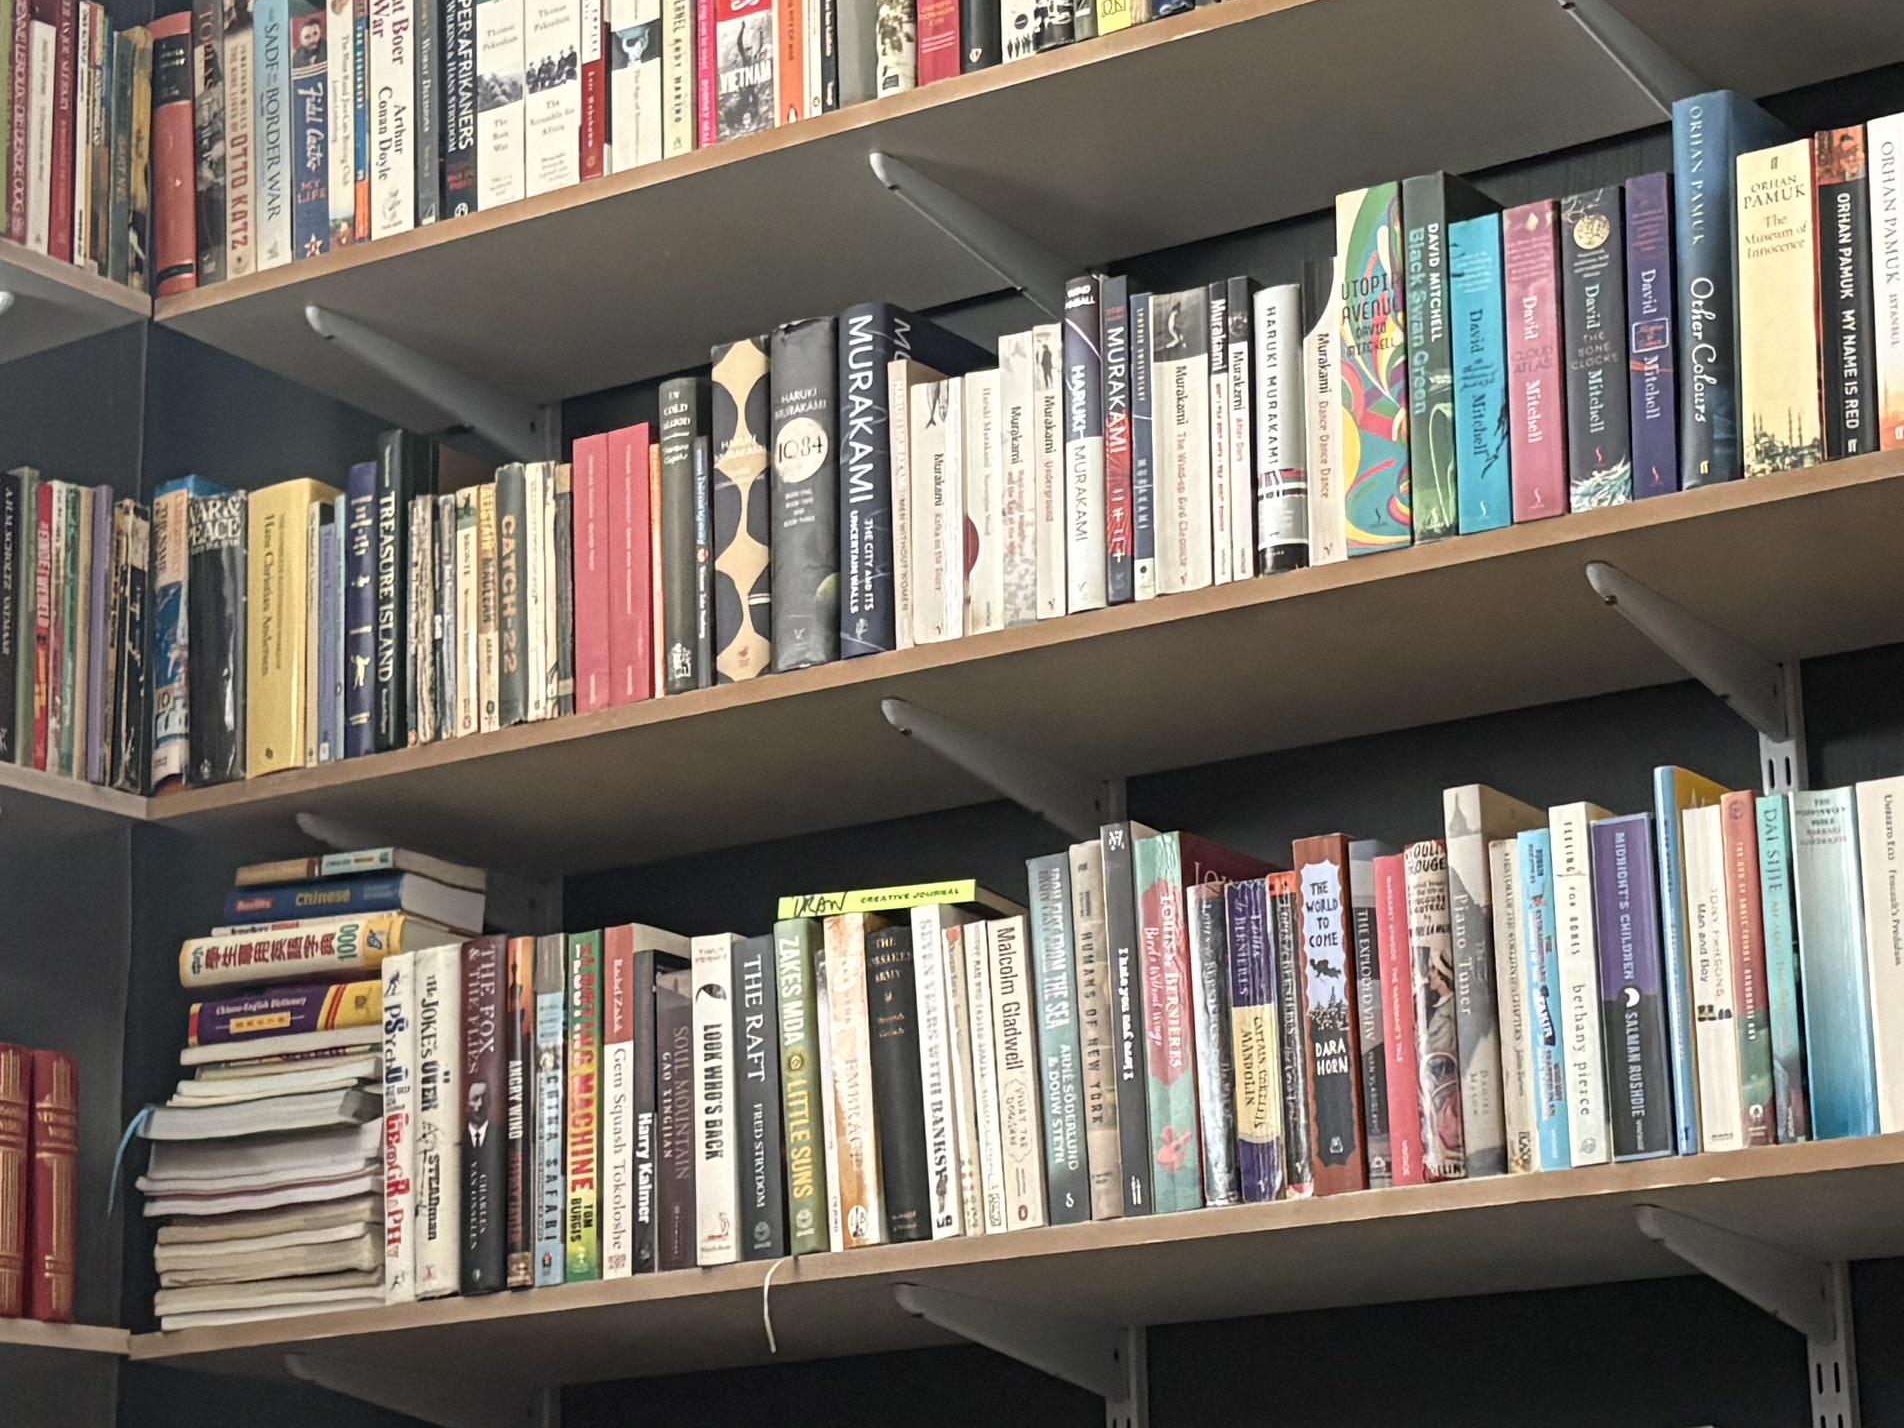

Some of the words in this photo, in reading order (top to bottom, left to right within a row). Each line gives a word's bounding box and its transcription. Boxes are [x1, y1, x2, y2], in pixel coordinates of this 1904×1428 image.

[718, 63, 773, 95] VIETNAM
[847, 314, 875, 505] MURAKAMI
[499, 514, 517, 674] CATCH-22
[1310, 880, 1329, 897] THE
[1306, 897, 1340, 914] WORLD
[1309, 931, 1339, 948] COME
[1317, 916, 1331, 931] TO
[997, 927, 1016, 997] Malcolm
[743, 953, 762, 1006] THE
[744, 1011, 766, 1083] RAFT
[1002, 1000, 1024, 1072] Gladwell
[1315, 1040, 1346, 1058] DARA
[1316, 1058, 1348, 1076] HORN
